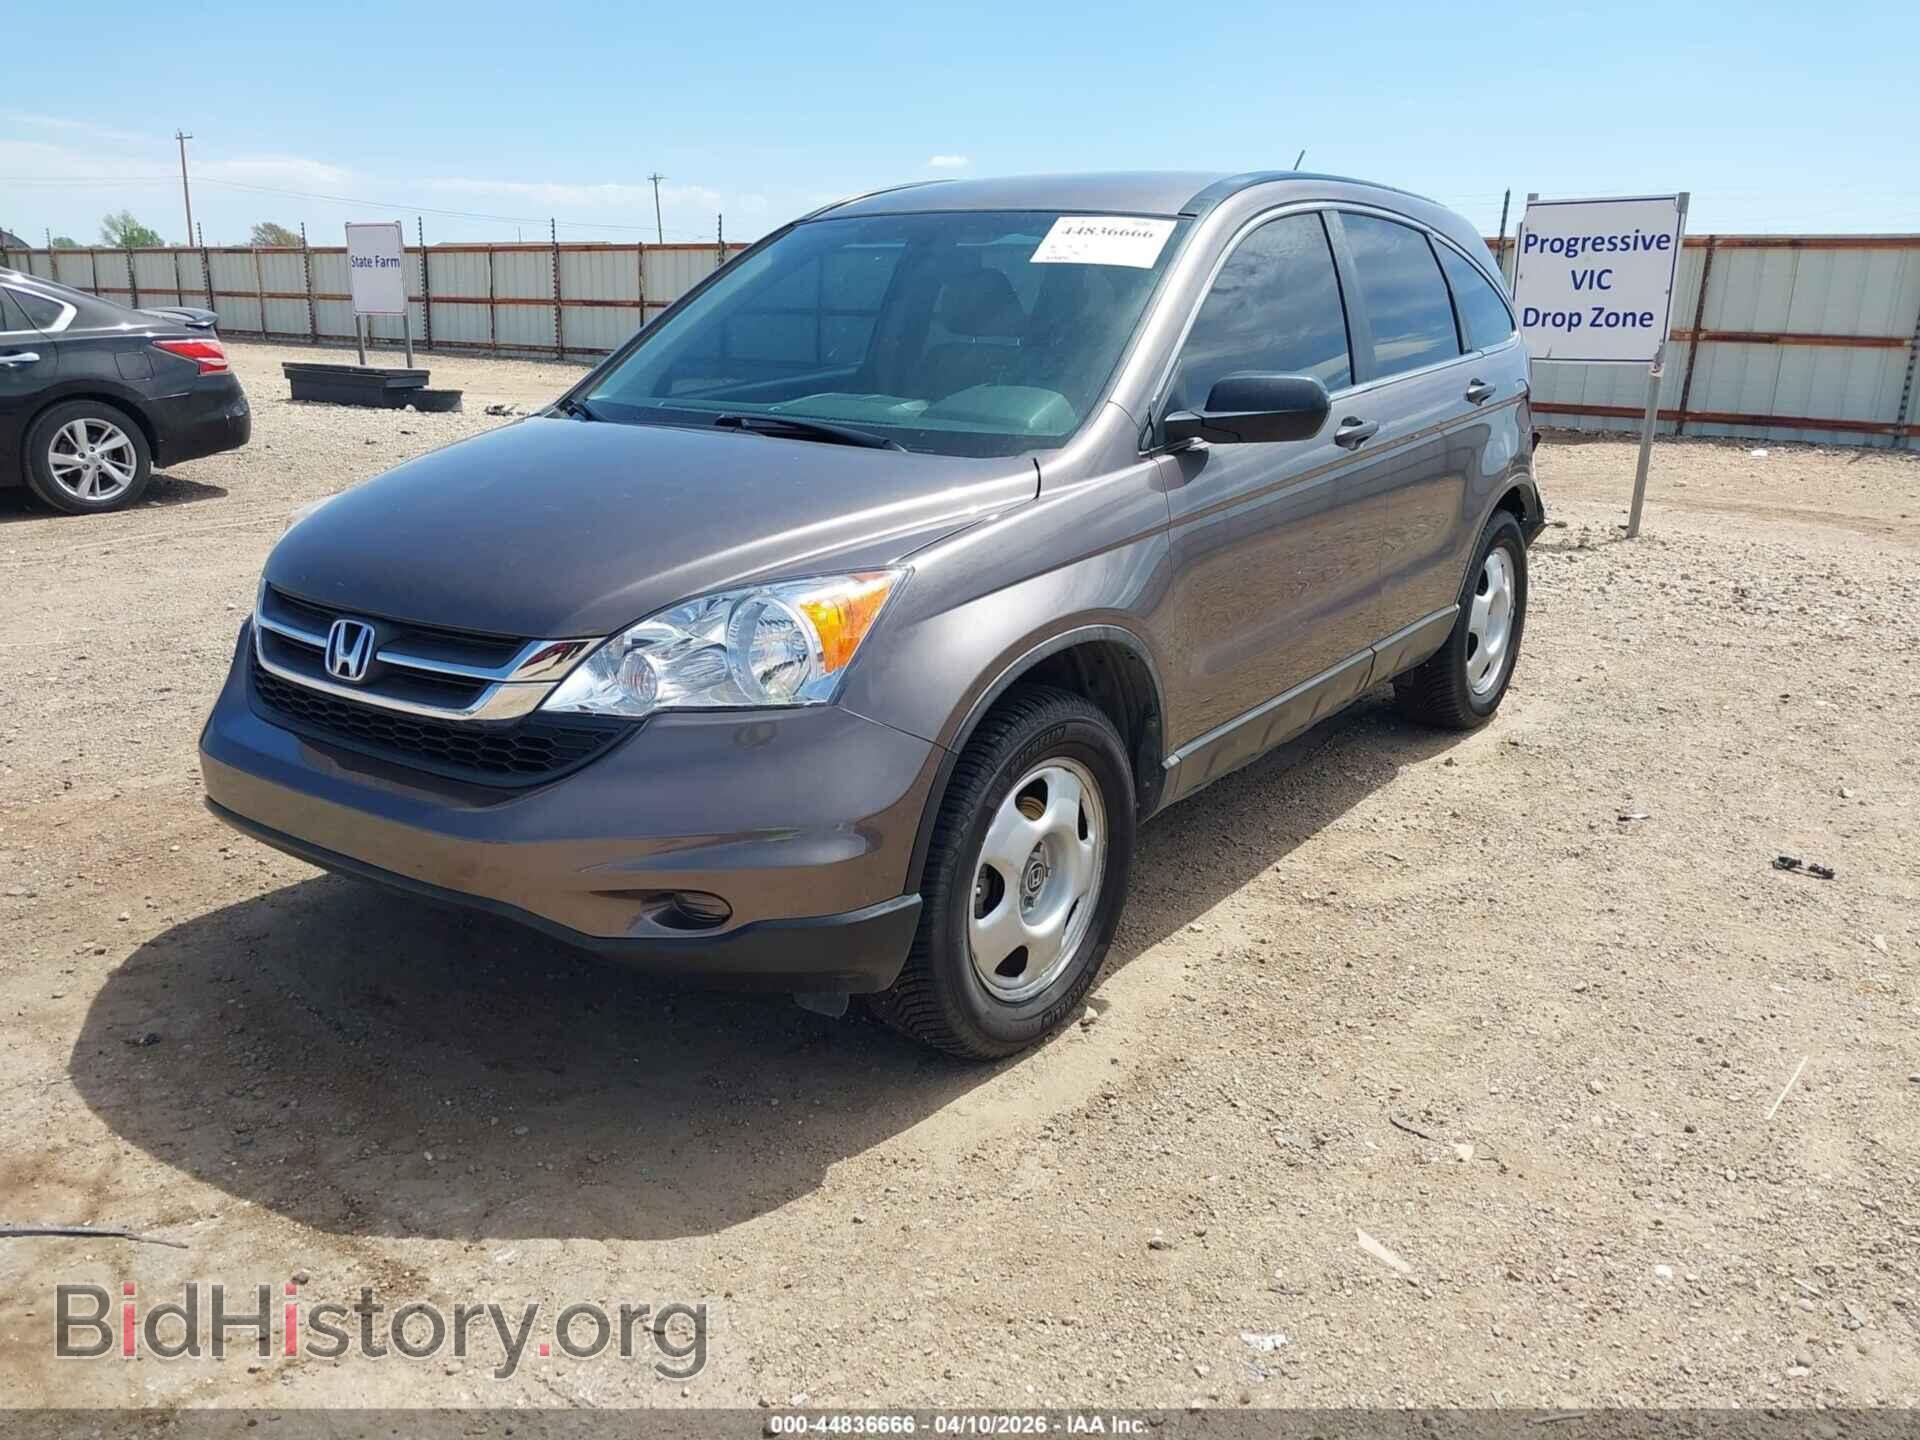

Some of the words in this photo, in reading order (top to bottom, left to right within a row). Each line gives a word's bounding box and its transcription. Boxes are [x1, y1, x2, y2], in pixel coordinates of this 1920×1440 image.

[1523, 229, 1671, 258] Progressive
[351, 255, 373, 268] State
[375, 255, 400, 268] Farm
[1571, 268, 1613, 290] VIC
[1522, 307, 1582, 332] Drop
[1589, 307, 1654, 328] Zone
